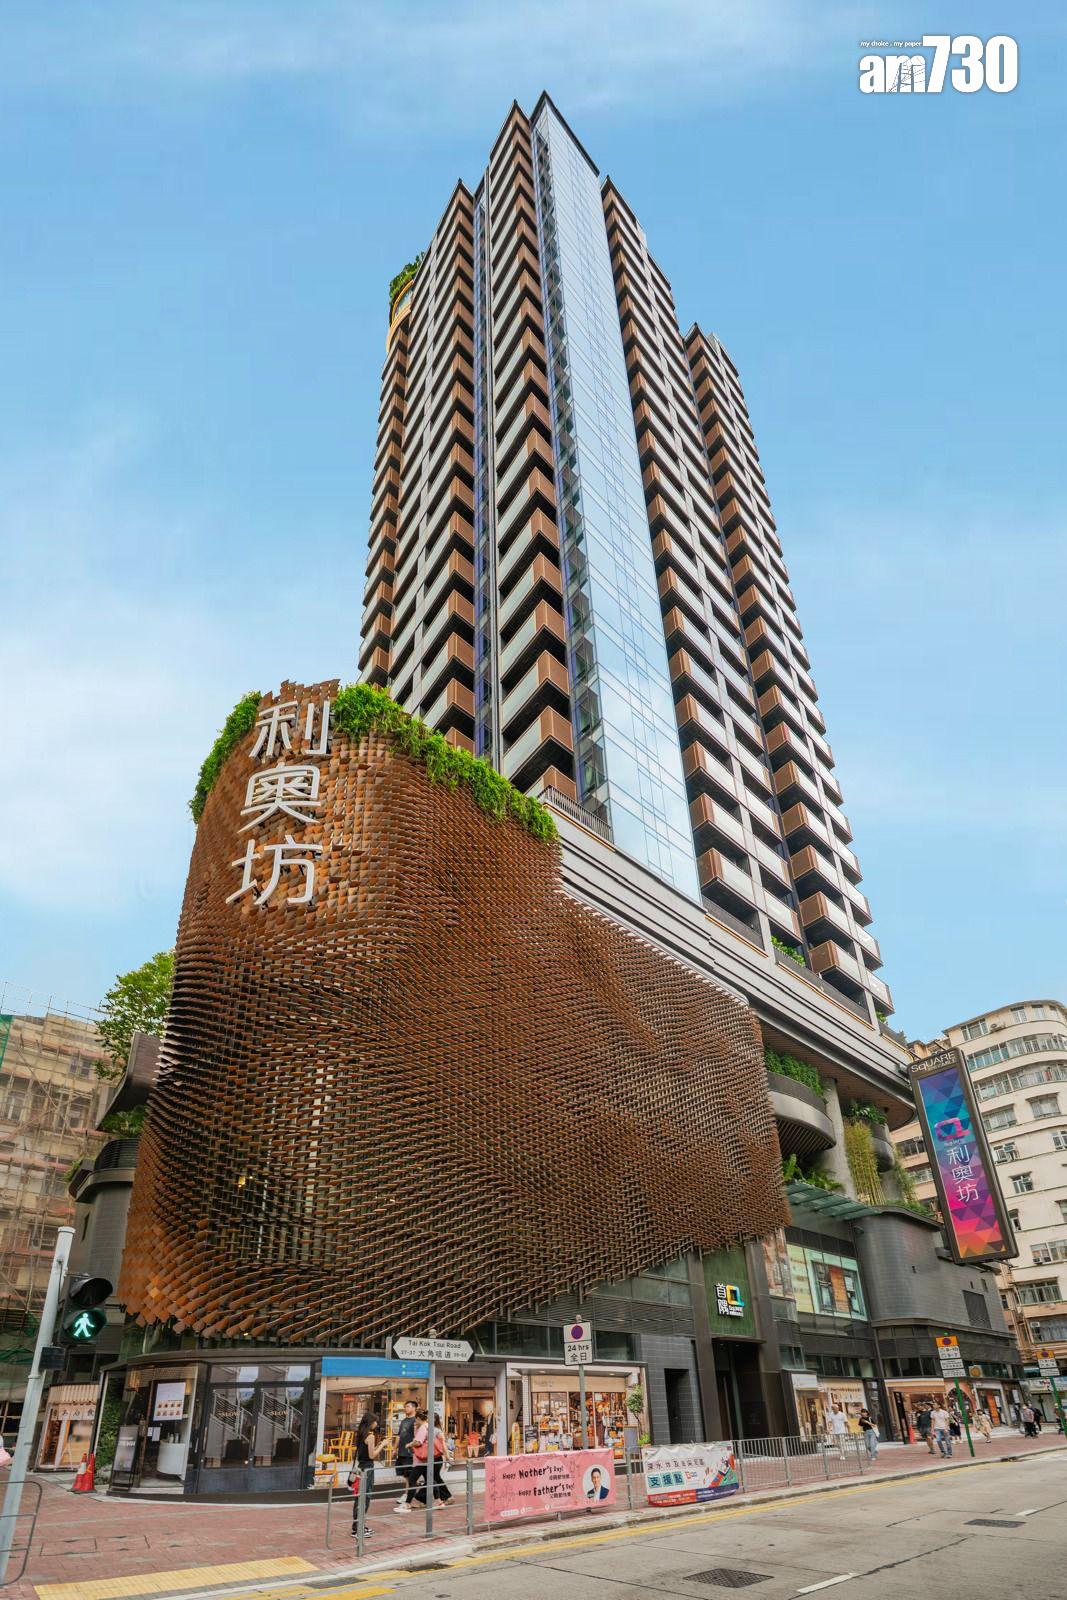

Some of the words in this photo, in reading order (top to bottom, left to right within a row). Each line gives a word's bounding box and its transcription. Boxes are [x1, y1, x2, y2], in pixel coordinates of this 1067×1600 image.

[225, 700, 331, 905] 利奧坊
[946, 1144, 980, 1203] 利奧坊
[570, 1352, 587, 1362] 全日
[533, 1482, 565, 1497] Father's
